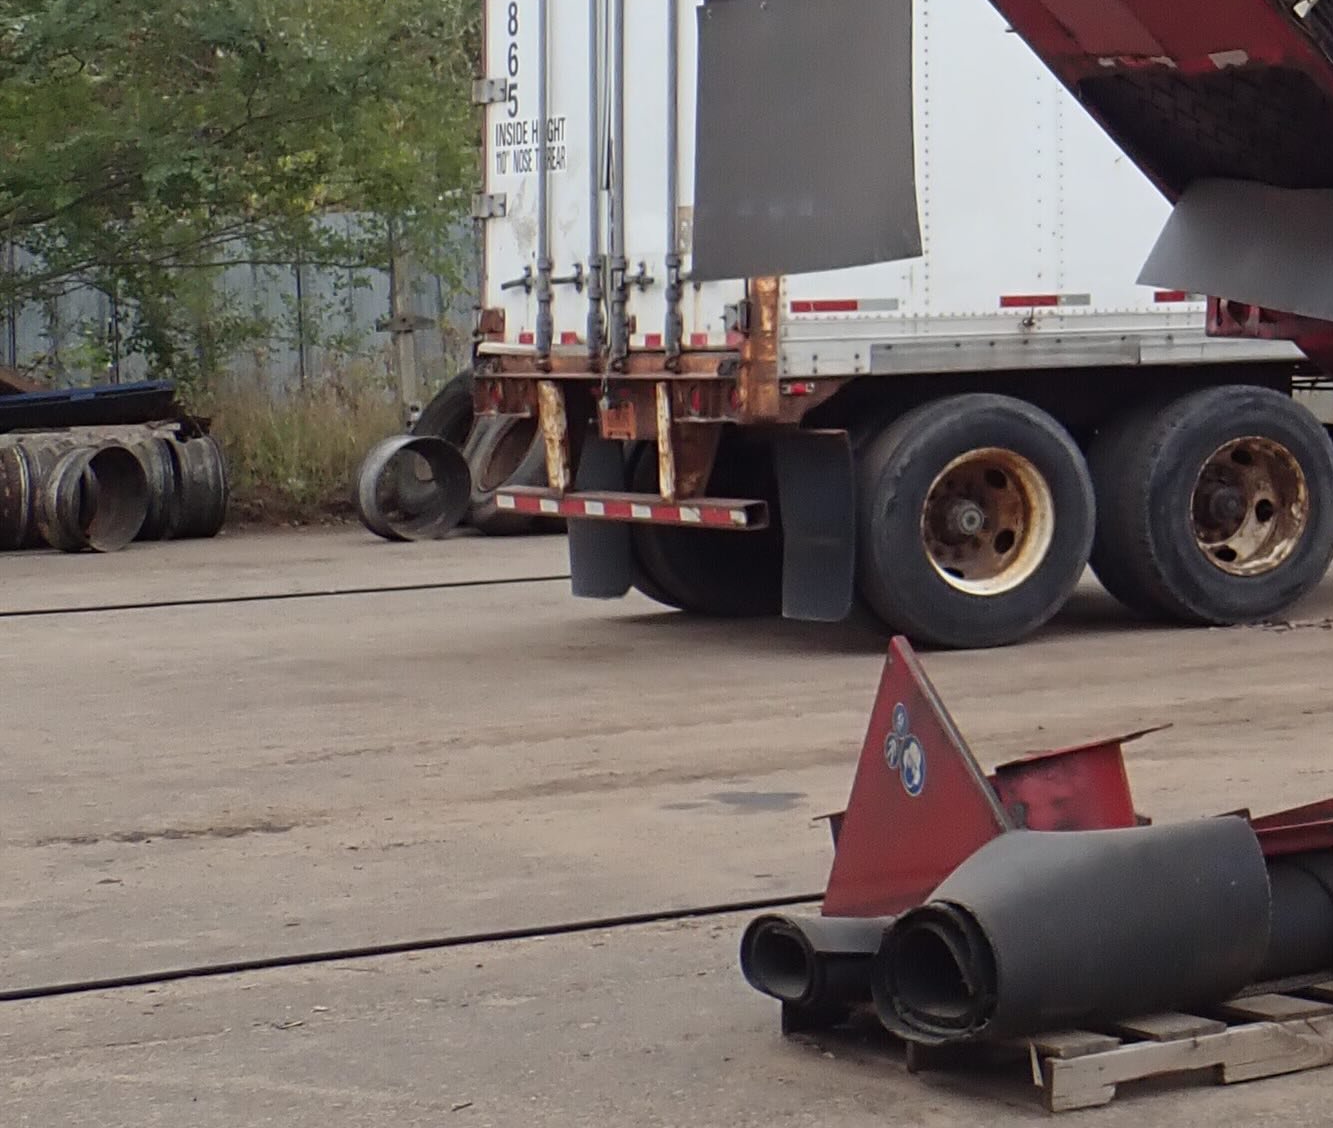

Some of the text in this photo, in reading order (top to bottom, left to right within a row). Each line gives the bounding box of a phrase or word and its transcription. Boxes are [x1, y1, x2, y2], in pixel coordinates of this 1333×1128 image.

[496, 117, 566, 147] INSIDE HGHT
[513, 148, 532, 173] NOSE
